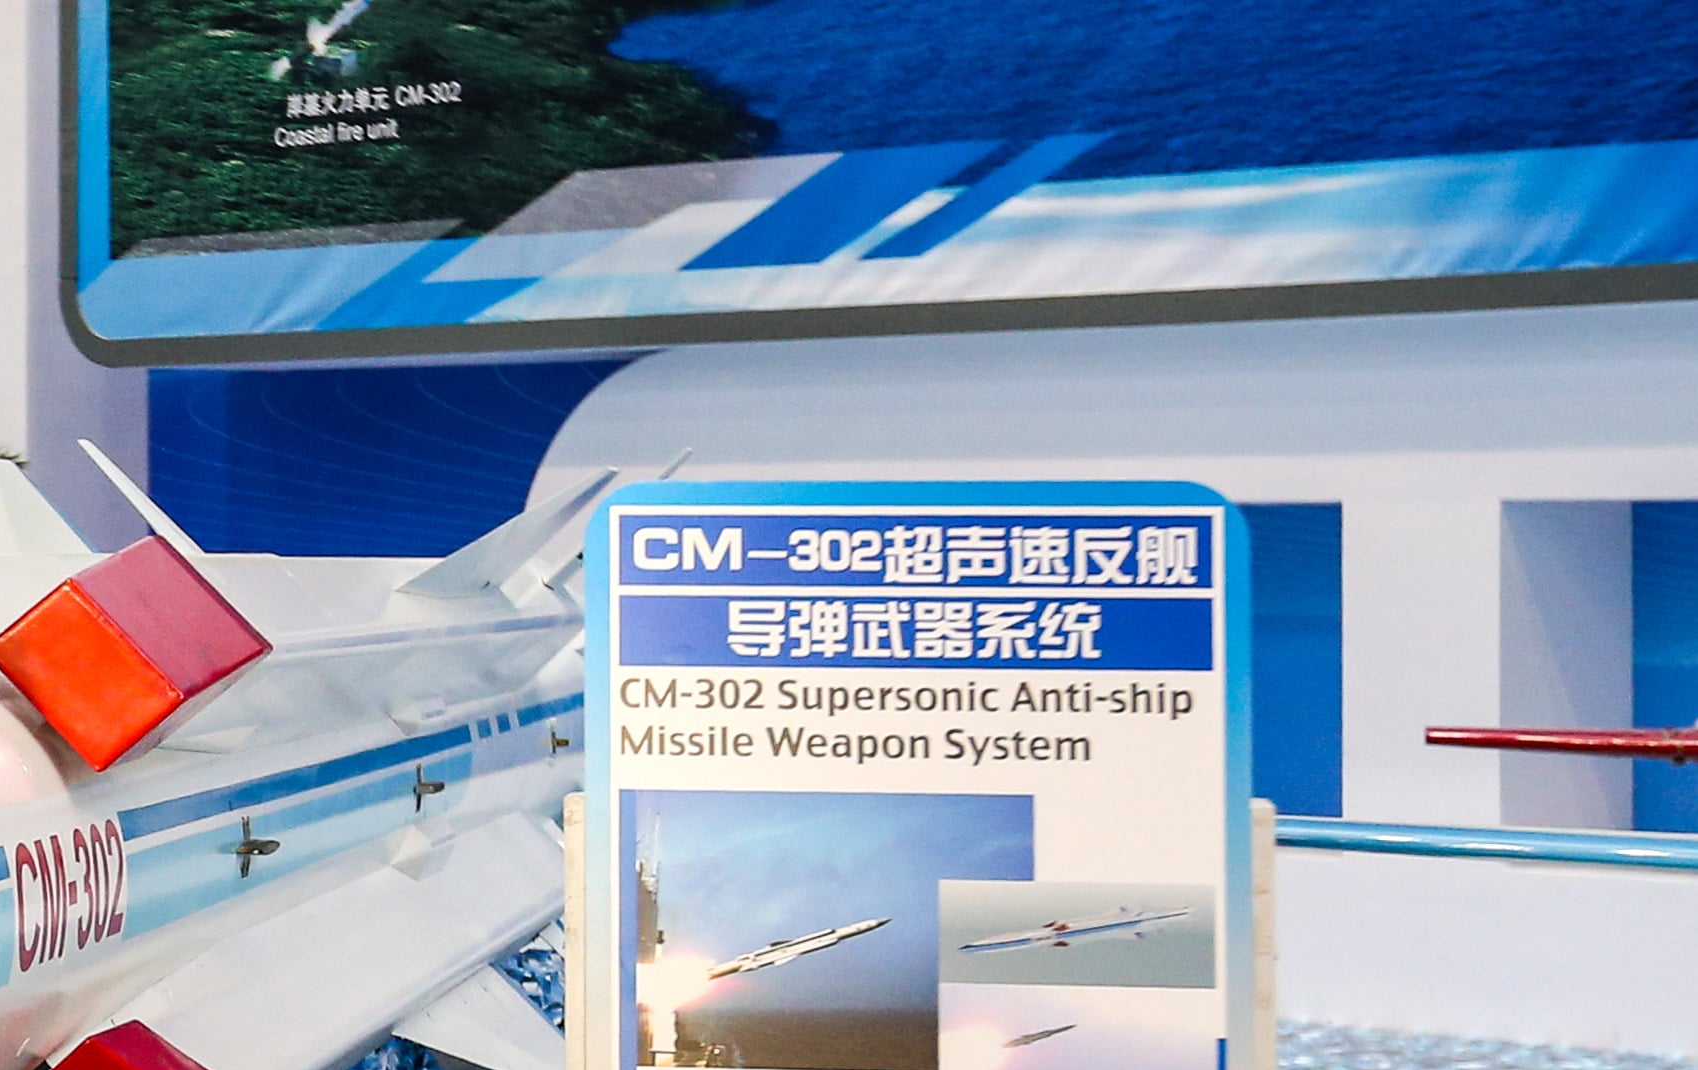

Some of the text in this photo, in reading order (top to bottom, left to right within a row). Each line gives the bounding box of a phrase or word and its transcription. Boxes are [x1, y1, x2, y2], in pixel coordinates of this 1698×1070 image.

[394, 80, 462, 107] CM-302
[274, 117, 400, 148] Coastal fire unit
[632, 525, 1199, 585] CM-302超声速反舰
[726, 599, 1103, 660] 导弹武器系统
[619, 679, 1194, 721] CM-302 Supersonic Anti-ship
[619, 725, 1091, 766] Missile Weapon System
[15, 819, 124, 972] CM-302
